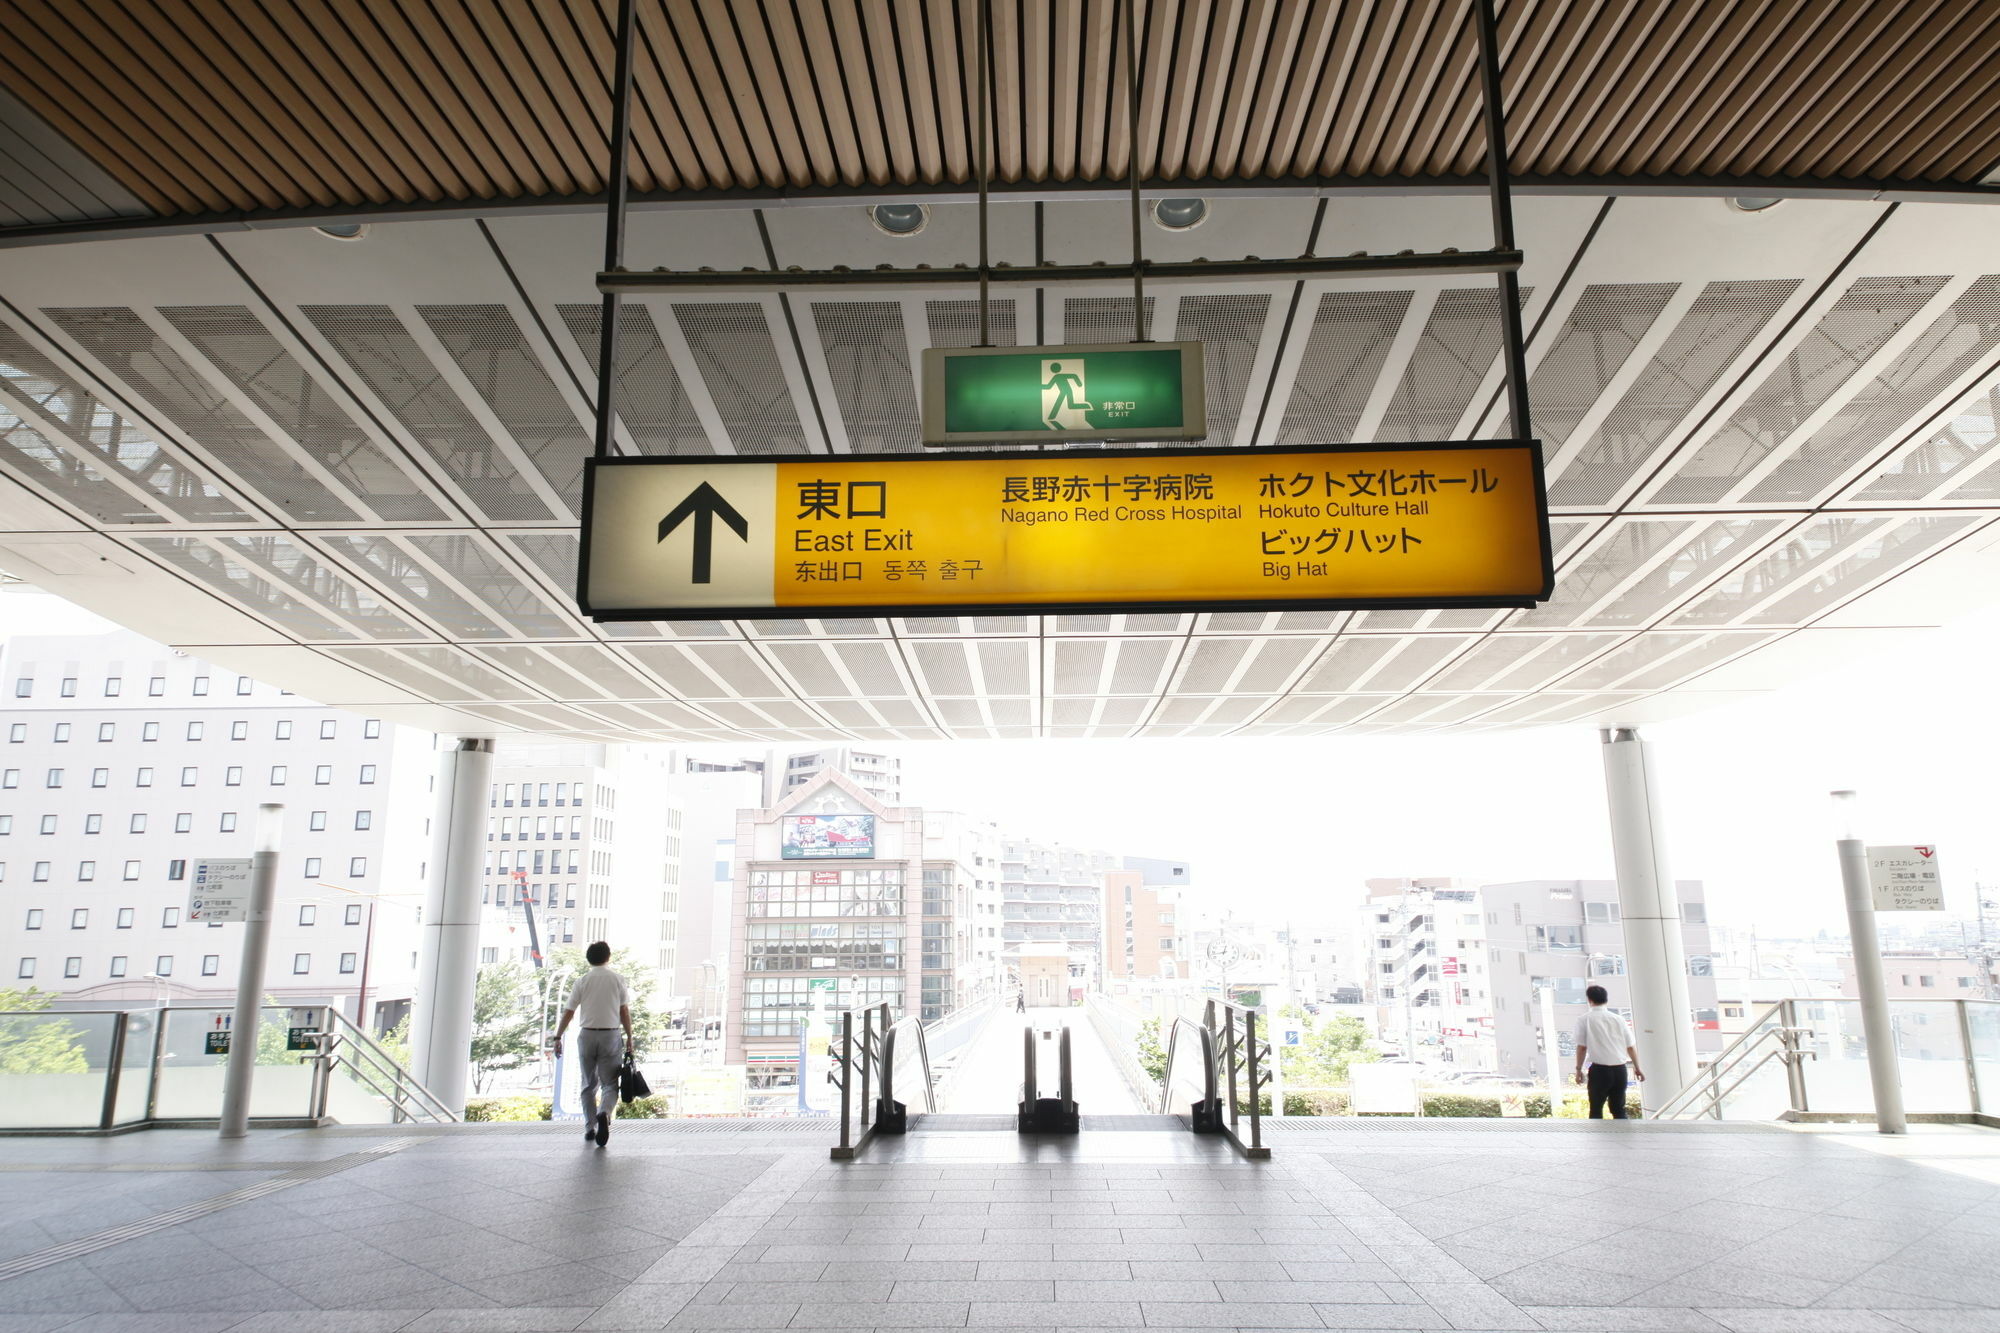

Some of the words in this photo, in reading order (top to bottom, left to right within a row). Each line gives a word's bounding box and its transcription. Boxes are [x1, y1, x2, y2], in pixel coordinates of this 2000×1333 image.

[1102, 401, 1136, 411] 非常口
[1002, 473, 1214, 503] 長野赤十字病院
[1259, 468, 1499, 499] ホクト文化ホール
[796, 478, 887, 522] 東口
[1258, 502, 1321, 519] Hokuto
[1325, 501, 1390, 517] Culture
[1395, 499, 1429, 516] Hall
[1001, 507, 1069, 526] Nagano
[1074, 506, 1111, 522] Red
[1116, 505, 1166, 521] Cross
[1172, 503, 1242, 525] Hospital
[795, 529, 854, 553] East
[864, 528, 914, 552] Exit
[1261, 527, 1422, 556] ビッグハット
[795, 560, 863, 583] 东出口
[883, 560, 927, 582] 동쪽
[938, 559, 984, 581] 출구
[1262, 560, 1292, 580] Big
[1296, 559, 1329, 576] Hat
